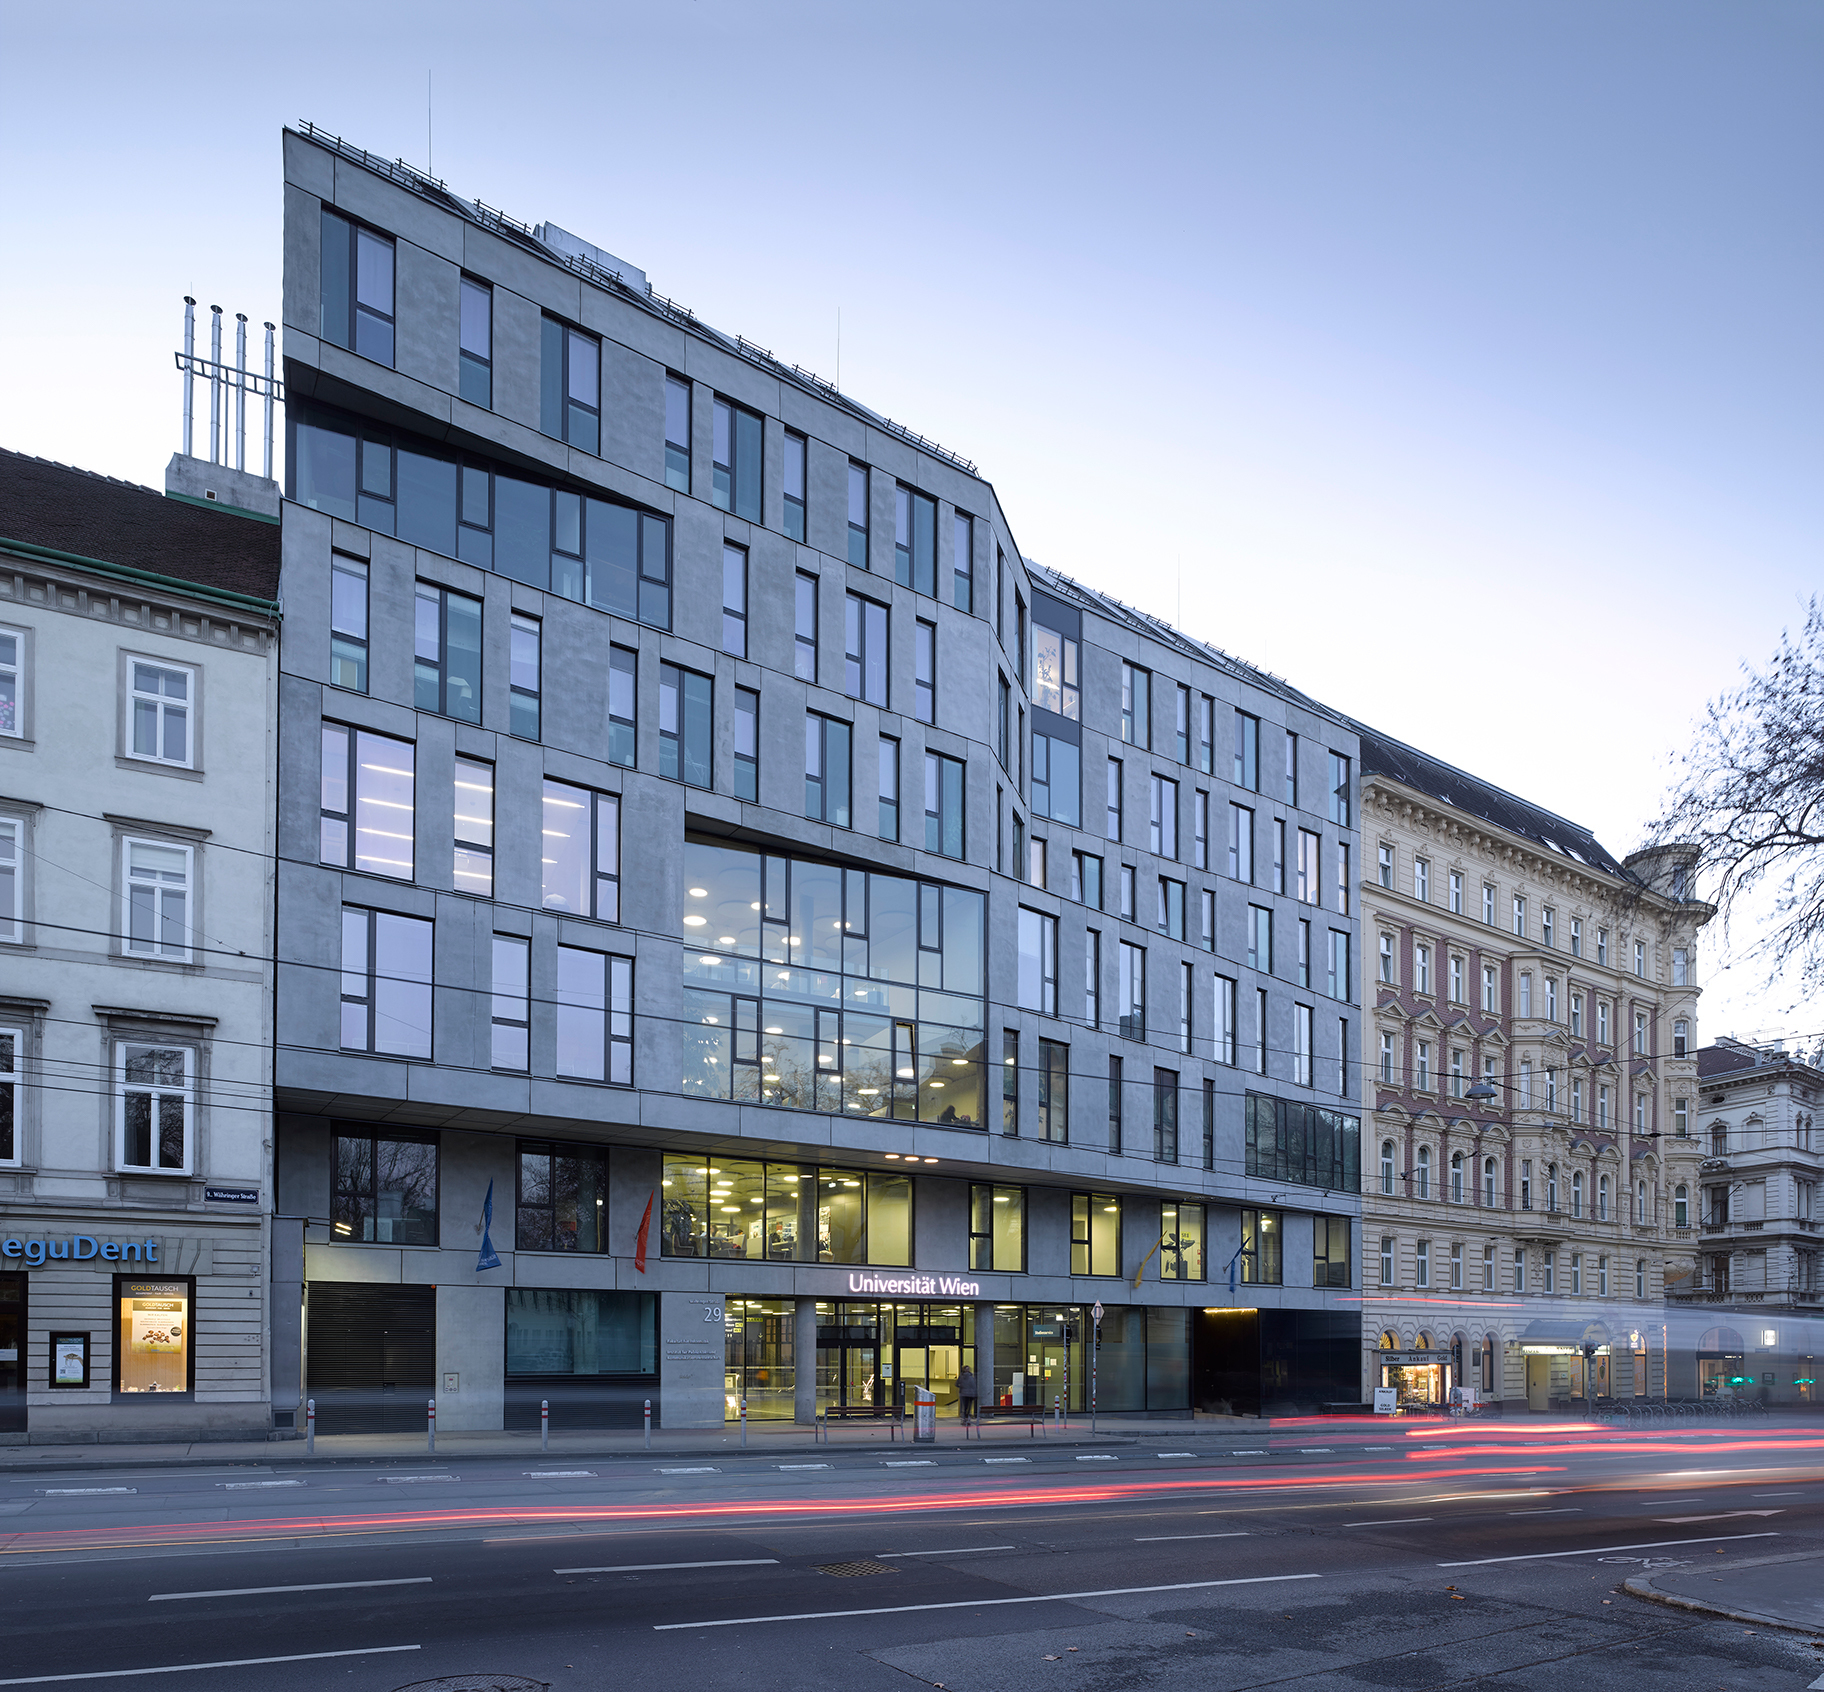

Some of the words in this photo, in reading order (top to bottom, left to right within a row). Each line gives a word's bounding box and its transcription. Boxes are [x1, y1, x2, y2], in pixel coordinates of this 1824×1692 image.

[849, 1273, 936, 1294] Universität
[939, 1277, 979, 1296] Wien
[704, 1307, 722, 1322] 29
